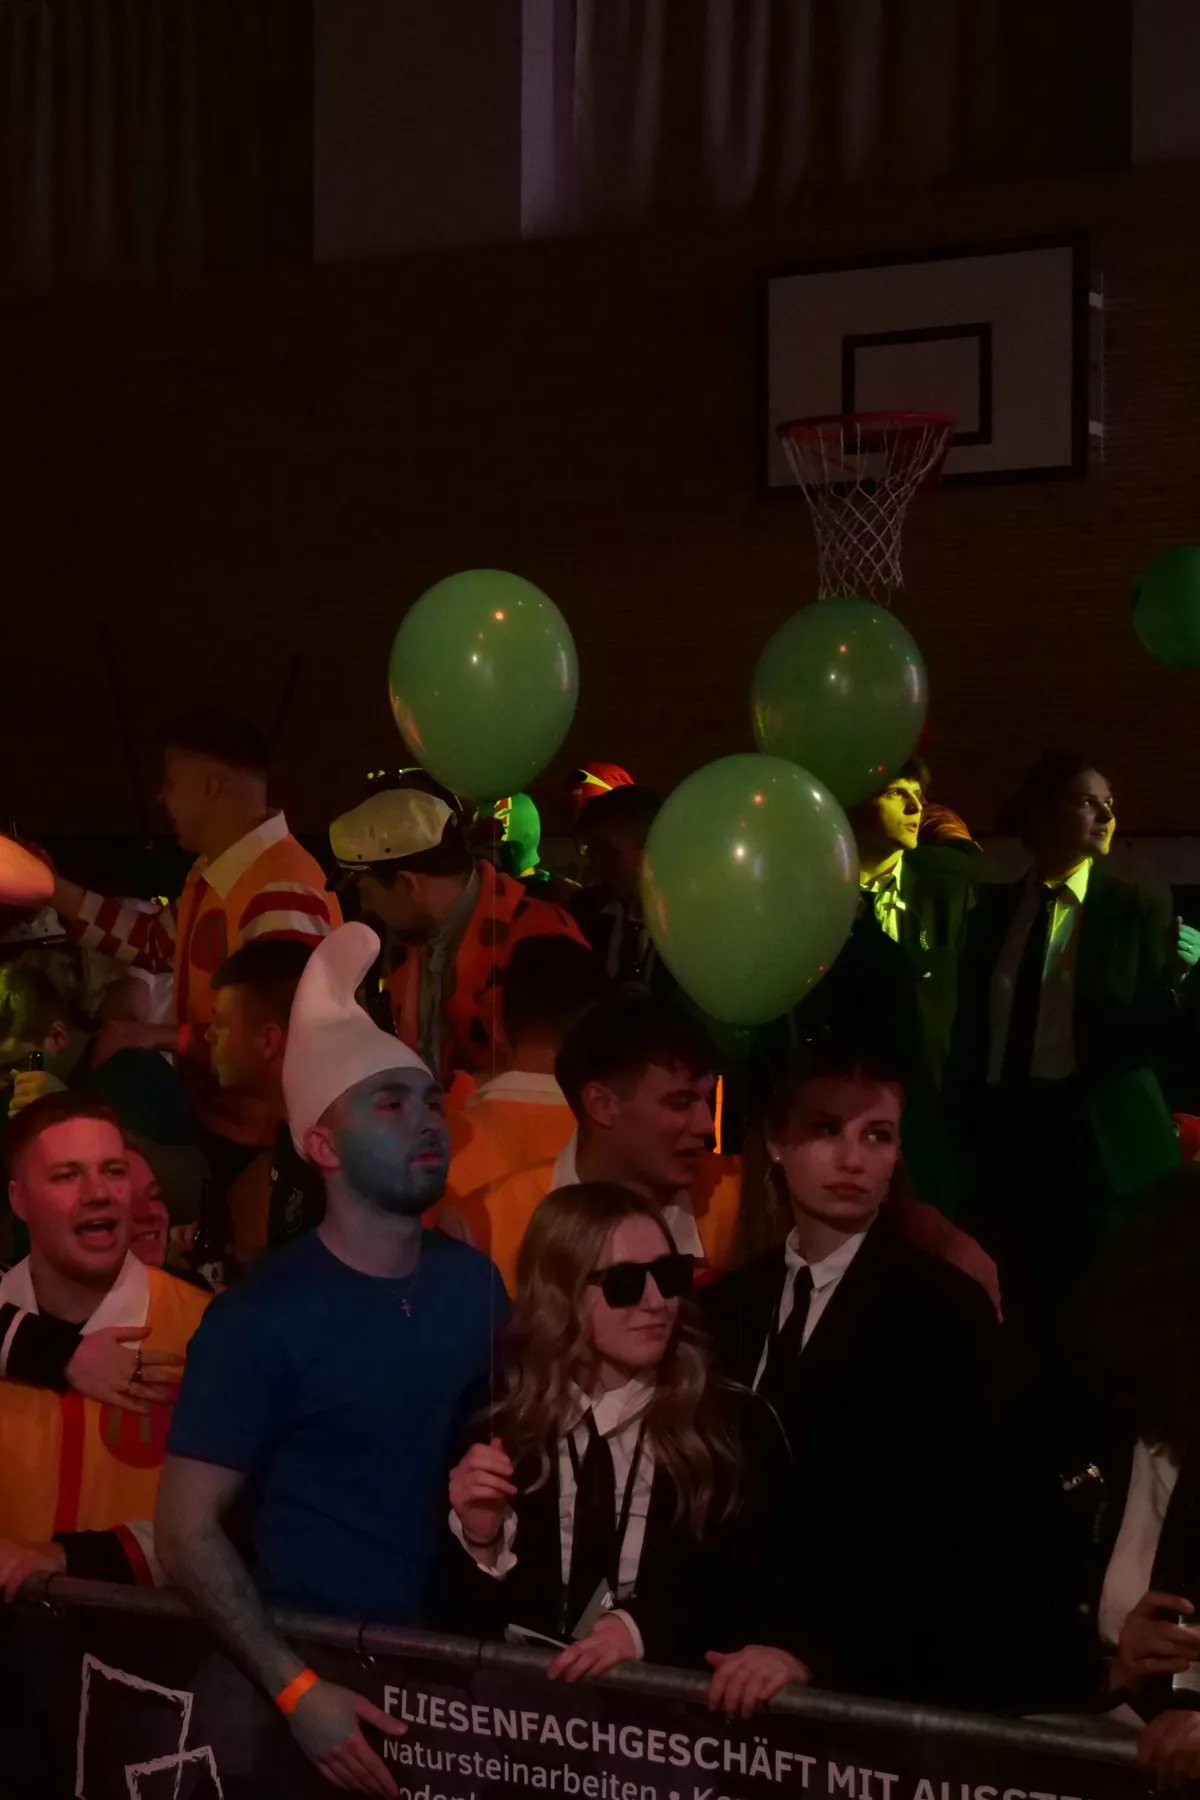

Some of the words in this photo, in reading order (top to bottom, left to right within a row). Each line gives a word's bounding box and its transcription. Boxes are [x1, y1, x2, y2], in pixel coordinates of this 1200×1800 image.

[383, 1684, 817, 1788] FLIESENFACHGESCHÄFT
[827, 1760, 900, 1800] MIT
[383, 1737, 657, 1800] Natursteinarbeiten
